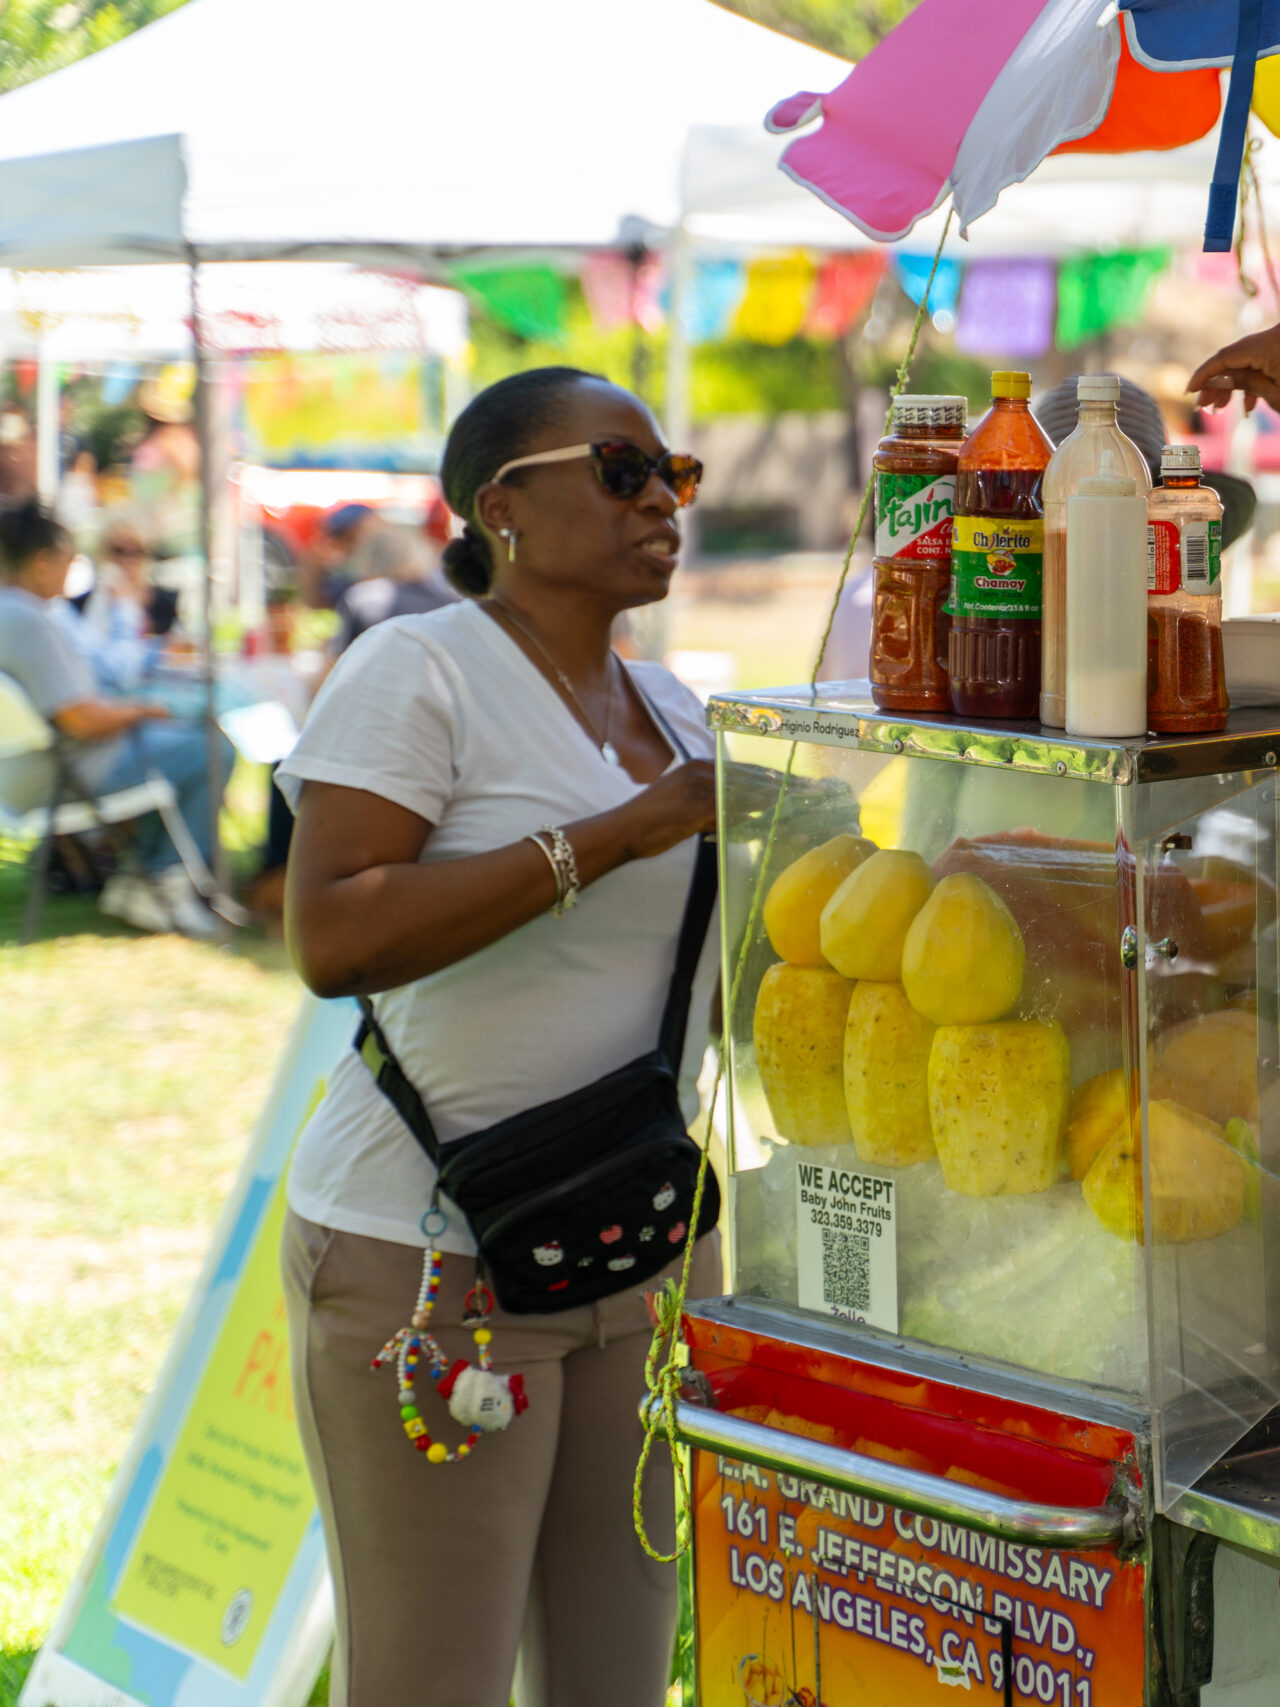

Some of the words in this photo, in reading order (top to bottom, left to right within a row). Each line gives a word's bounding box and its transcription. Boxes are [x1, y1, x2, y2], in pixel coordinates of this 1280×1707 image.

[974, 576, 1026, 592] Chamoy
[813, 721, 860, 739] Rodriguez
[798, 1163, 823, 1189] WE
[828, 1170, 893, 1204] ACCEPT
[801, 1189, 827, 1209] Baby
[830, 1195, 857, 1214] John
[860, 1202, 892, 1221] Fruits
[810, 1209, 882, 1237] 323.359.3379
[777, 1471, 885, 1528] GRAND
[893, 1506, 1112, 1607] COMMISSARY
[721, 1496, 767, 1541] 161
[779, 1514, 803, 1555] E.
[812, 1528, 984, 1624] JEFFERSON
[731, 1547, 784, 1599] LOS
[792, 1581, 935, 1664] ANGELES,
[942, 1631, 983, 1681] CA
[989, 1651, 1091, 1707] 90011
